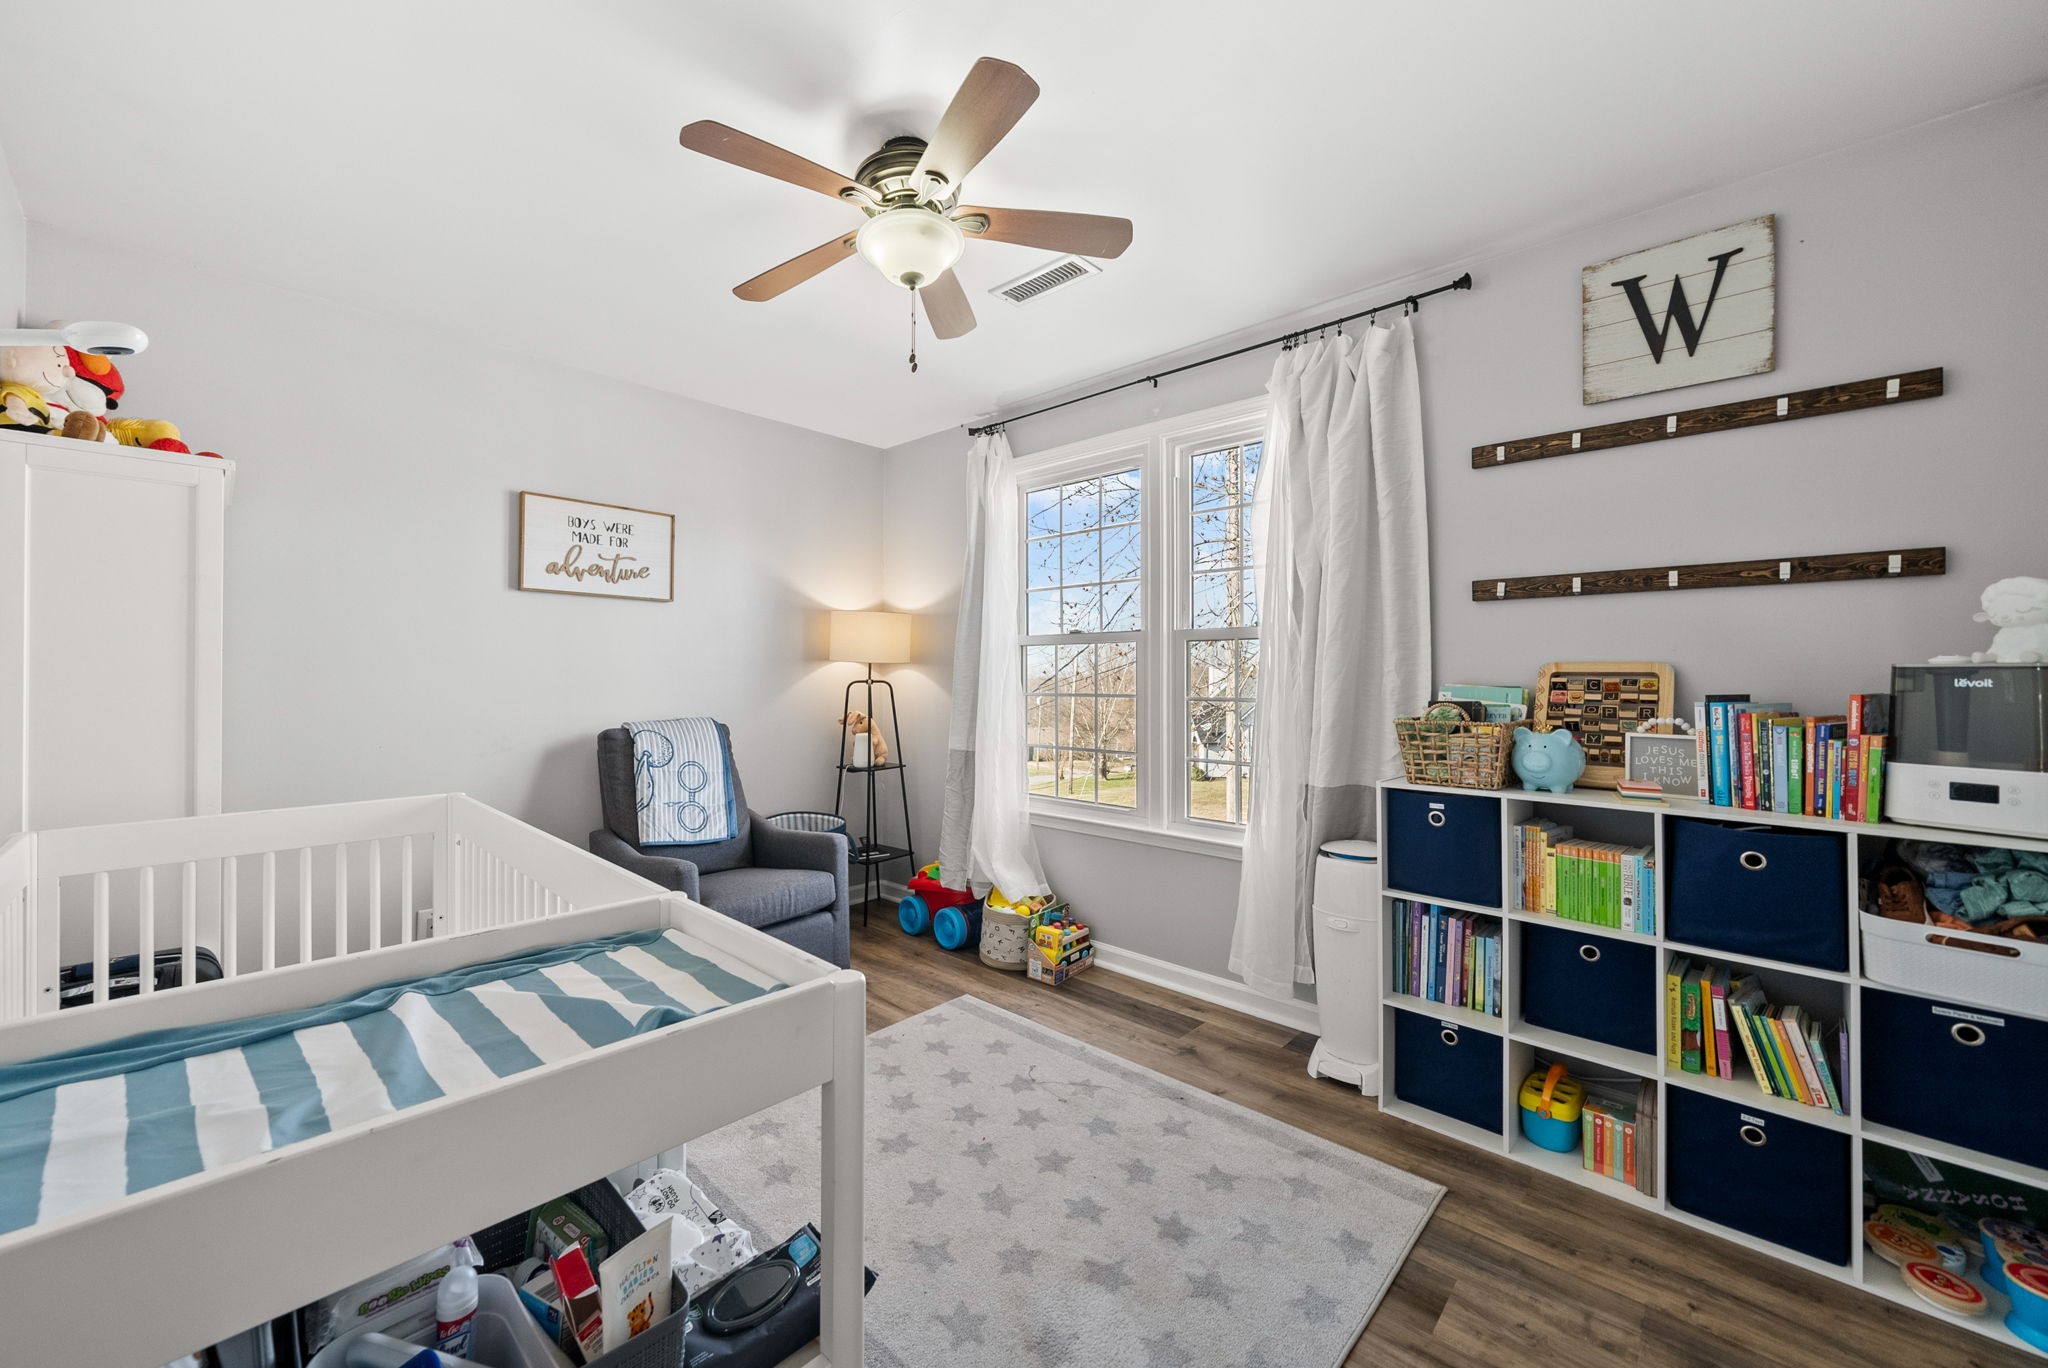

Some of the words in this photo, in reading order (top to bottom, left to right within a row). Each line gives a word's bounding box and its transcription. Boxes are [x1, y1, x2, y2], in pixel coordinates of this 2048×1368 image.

[1611, 247, 1744, 365] W
[567, 515, 596, 531] BOYS
[603, 521, 635, 536] WERE
[571, 531, 603, 545] MADE
[609, 536, 629, 548] FOR
[545, 544, 651, 584] adventure
[1646, 745, 1686, 758] JESUS
[1635, 755, 1674, 766] LOVES
[1679, 758, 1697, 768] ME
[1649, 766, 1684, 776] THIS
[1653, 776, 1693, 787] KNOW
[1622, 874, 1633, 897] BIBLE
[667, 1184, 680, 1203] FLUSH
